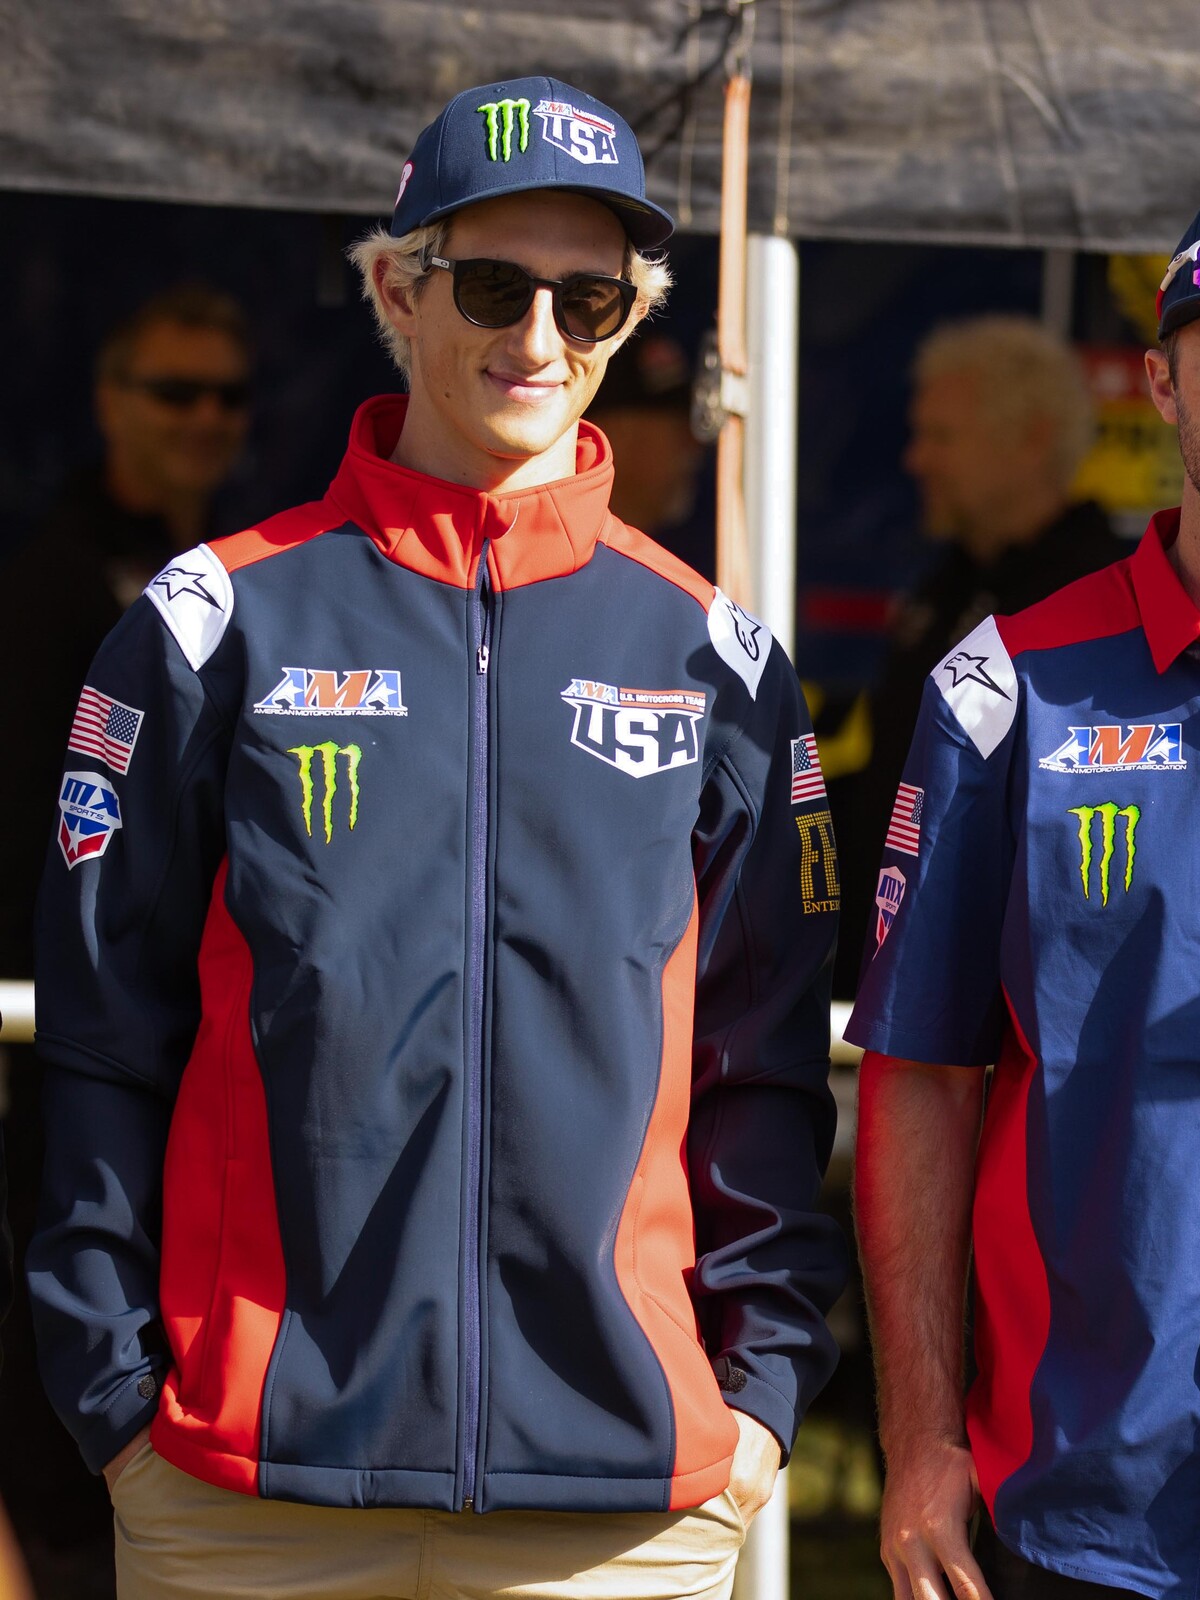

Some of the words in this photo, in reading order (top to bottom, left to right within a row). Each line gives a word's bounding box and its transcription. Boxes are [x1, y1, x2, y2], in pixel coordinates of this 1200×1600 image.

[533, 100, 573, 117] AMA
[543, 113, 618, 163] USA
[253, 667, 408, 711] AMA
[560, 679, 620, 706] AMA
[636, 694, 684, 704] MOTOCROSS
[574, 703, 698, 775] USA
[1038, 723, 1187, 767] AMA
[61, 777, 121, 821] MX
[69, 804, 105, 821] SPORTS
